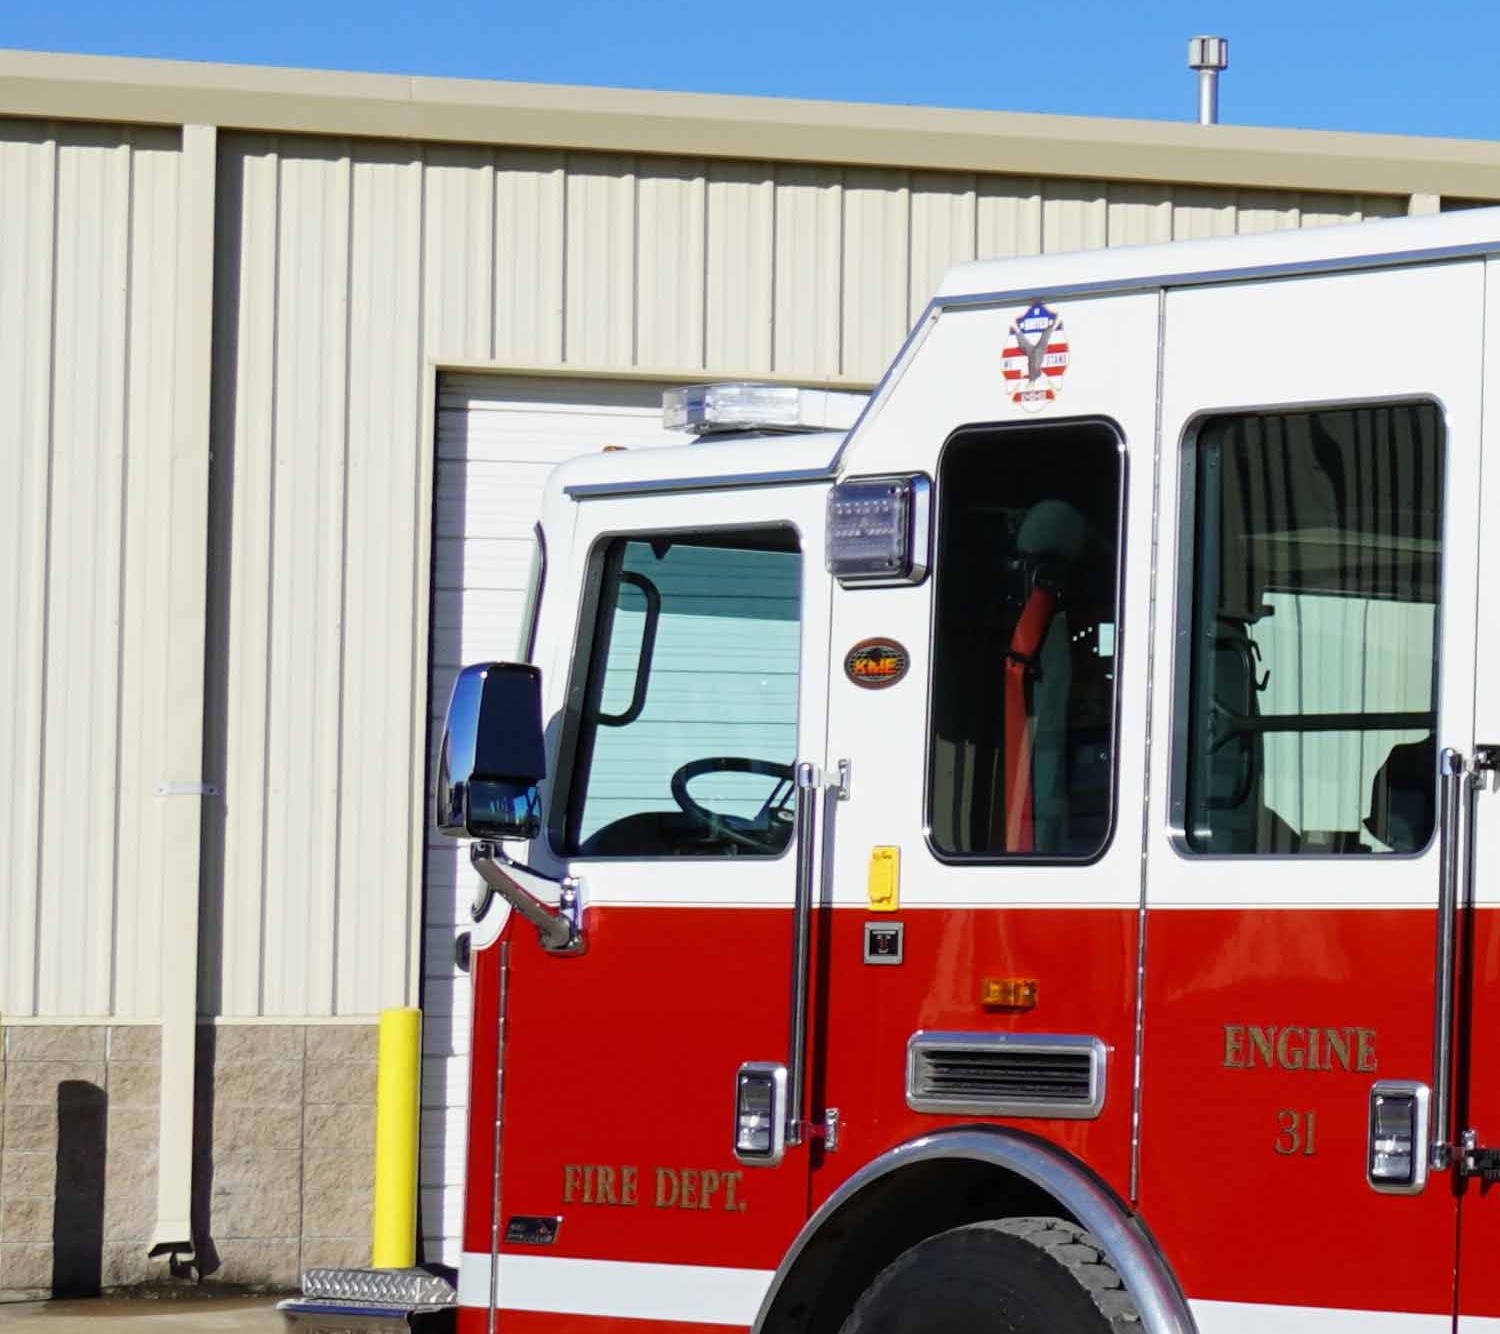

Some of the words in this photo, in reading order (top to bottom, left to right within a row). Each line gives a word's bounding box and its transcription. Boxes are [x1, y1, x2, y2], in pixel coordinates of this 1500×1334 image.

[852, 658, 897, 676] KME
[1222, 1024, 1378, 1073] ENGINE
[1274, 1110, 1317, 1155] 31
[562, 1164, 638, 1205] FIRE
[654, 1167, 747, 1211] DEPT.
